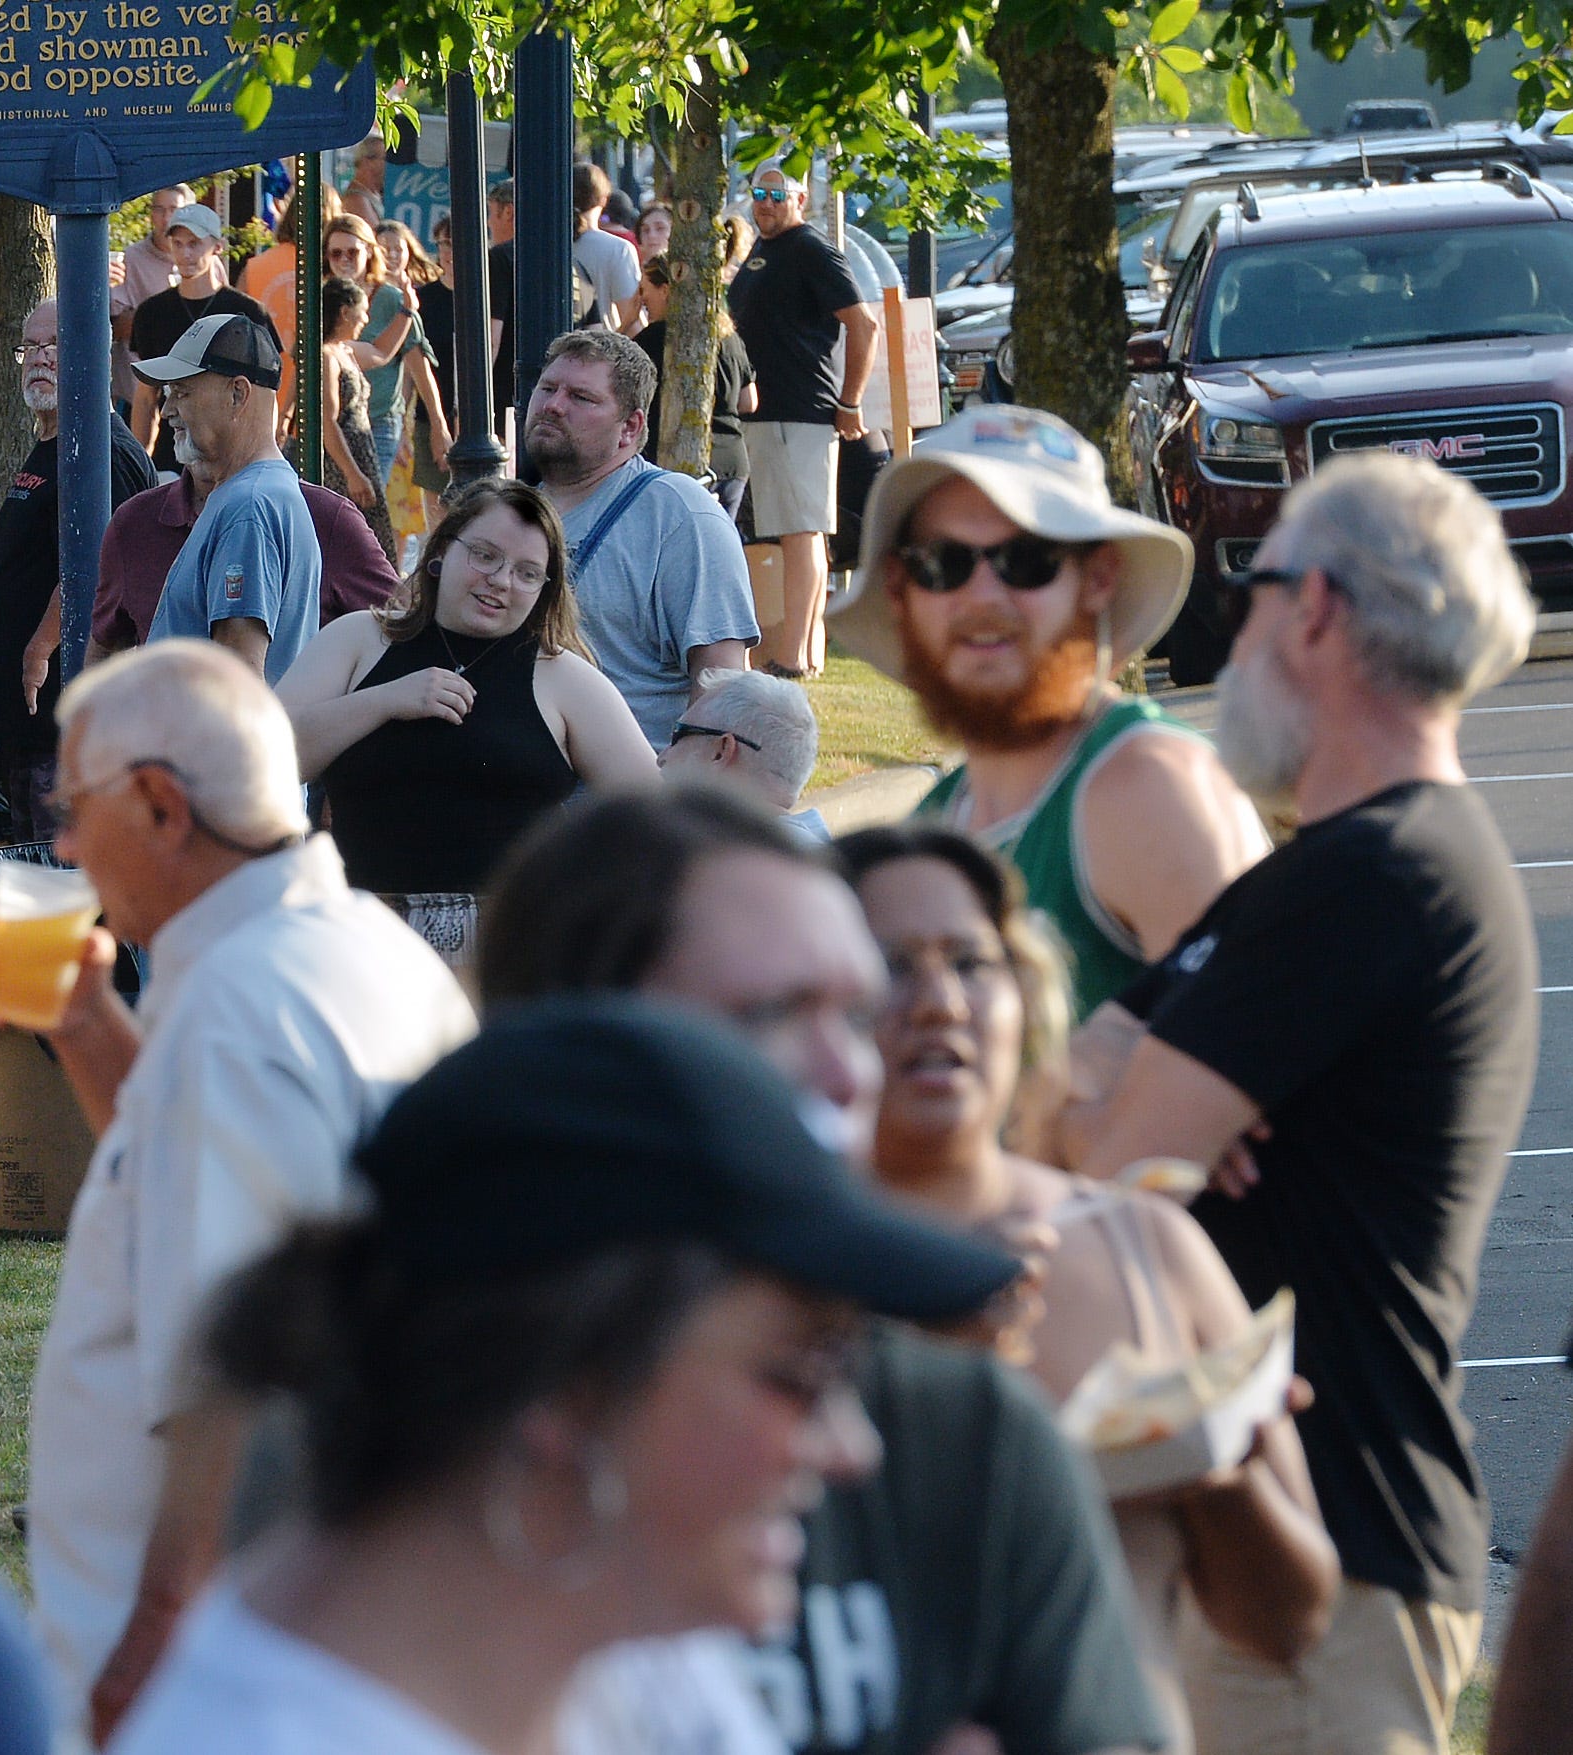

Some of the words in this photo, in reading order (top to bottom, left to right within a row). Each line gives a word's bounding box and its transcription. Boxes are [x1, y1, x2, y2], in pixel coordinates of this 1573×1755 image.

[45, 4, 88, 36] by
[103, 2, 161, 28] the
[45, 60, 202, 95] opposite.
[84, 107, 108, 118] AND
[124, 105, 173, 116] MUSEUM
[186, 103, 233, 113] COMMIS
[1389, 434, 1485, 460] GMC
